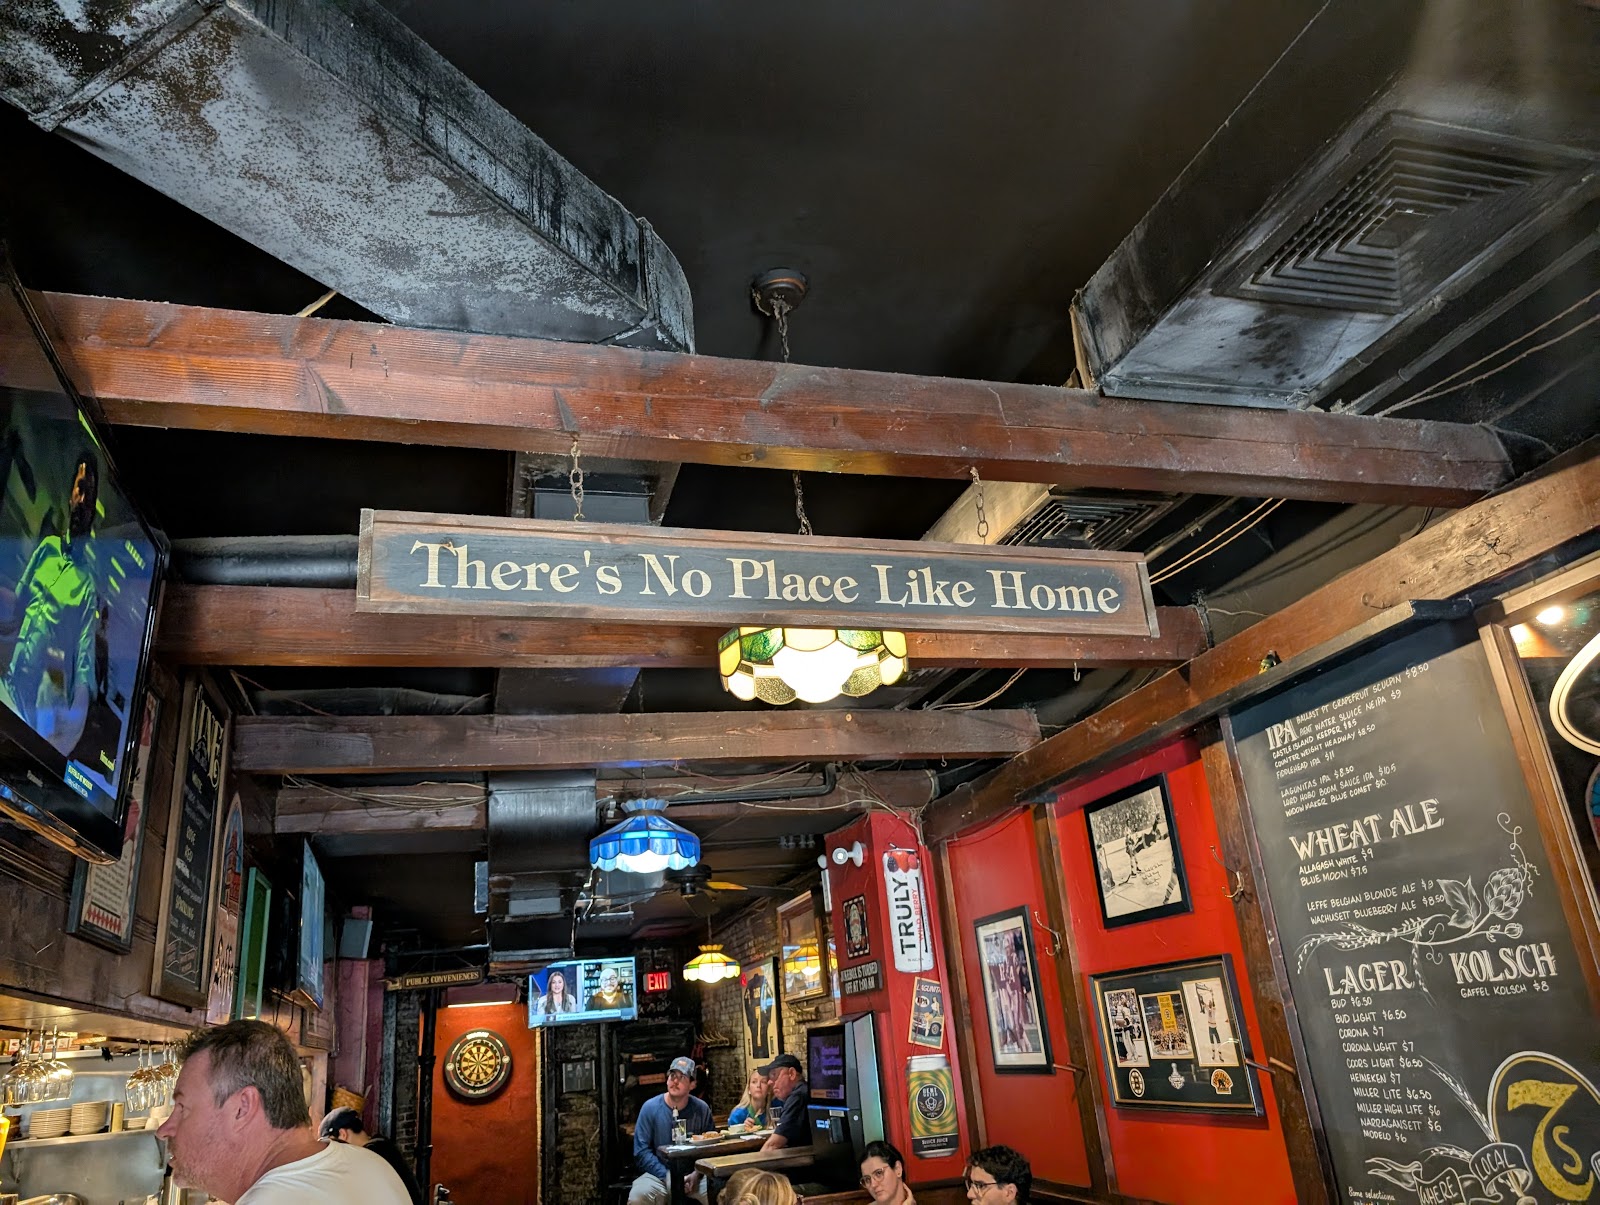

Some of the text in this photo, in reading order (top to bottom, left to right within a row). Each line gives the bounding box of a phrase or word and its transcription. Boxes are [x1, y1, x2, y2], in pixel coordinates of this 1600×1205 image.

[410, 539, 1121, 614] There's No Place Like Home
[1296, 662, 1429, 725] BALLAST PT GRAPEFRUIT SCULPIN $8.50
[1315, 716, 1337, 731] WATER
[1339, 705, 1362, 722] SLUICE
[1365, 696, 1387, 710] NEIPA
[1391, 689, 1402, 700] $9
[1265, 718, 1299, 750] IPA
[1272, 745, 1292, 759] CASTLE
[1293, 735, 1314, 750] ISLAND
[1316, 725, 1342, 740] KEEPER
[1325, 732, 1355, 748] HEADWAY
[1358, 723, 1376, 737] $8.50
[1276, 750, 1335, 779] FIDDLEHEAD IPA $11
[1281, 765, 1354, 798] LAGUNITAS IPA $8.50
[1283, 763, 1396, 807] LORD HOBO BOOM SAUCE IPA $10.5
[1330, 791, 1348, 803] BLUE
[1349, 783, 1372, 797] COMET
[1288, 798, 1445, 861] WHEAT ALE
[1299, 847, 1374, 875] ALLAGASH WHITE $9
[1300, 875, 1321, 887] BLUE
[1322, 868, 1348, 882] MOON
[912, 888, 921, 915] BERRY
[1307, 900, 1327, 911] LEFFE
[1331, 893, 1362, 908] BELGIAN
[1364, 887, 1398, 901] BLONDE
[1402, 882, 1416, 894] ALE
[1310, 894, 1445, 925] WACHUSETT BLUEBERRY ALE $8.50
[892, 877, 917, 955] TRULY
[1449, 942, 1558, 984] KOLSCH
[406, 971, 479, 986] PUBLIC CONVENIENCES
[648, 972, 668, 991] EXIT
[916, 984, 942, 993] LAGUNITA
[1323, 960, 1415, 995] LAGER
[1460, 980, 1550, 998] GAFFEL KOLSCH $8
[1331, 995, 1372, 1008] BUD $6.50
[1334, 1009, 1407, 1023] BUD LIGHT $6.50
[1338, 1025, 1384, 1039] CORONA $7
[1342, 1040, 1414, 1052] CORONA LIGHT $7
[1346, 1055, 1423, 1068] COORS LIGHT $6.50
[1349, 1071, 1401, 1084] HEINEKEN $7
[1353, 1087, 1432, 1100] MILLER LITE $6.50
[1356, 1102, 1440, 1116] MILLER HIGH LIFE $6
[1360, 1117, 1441, 1131] NARRAGANSETT $6
[1363, 1129, 1407, 1143] MODELO $6
[1474, 1148, 1516, 1181] LOCAL
[1416, 1176, 1459, 1205] WHERE
